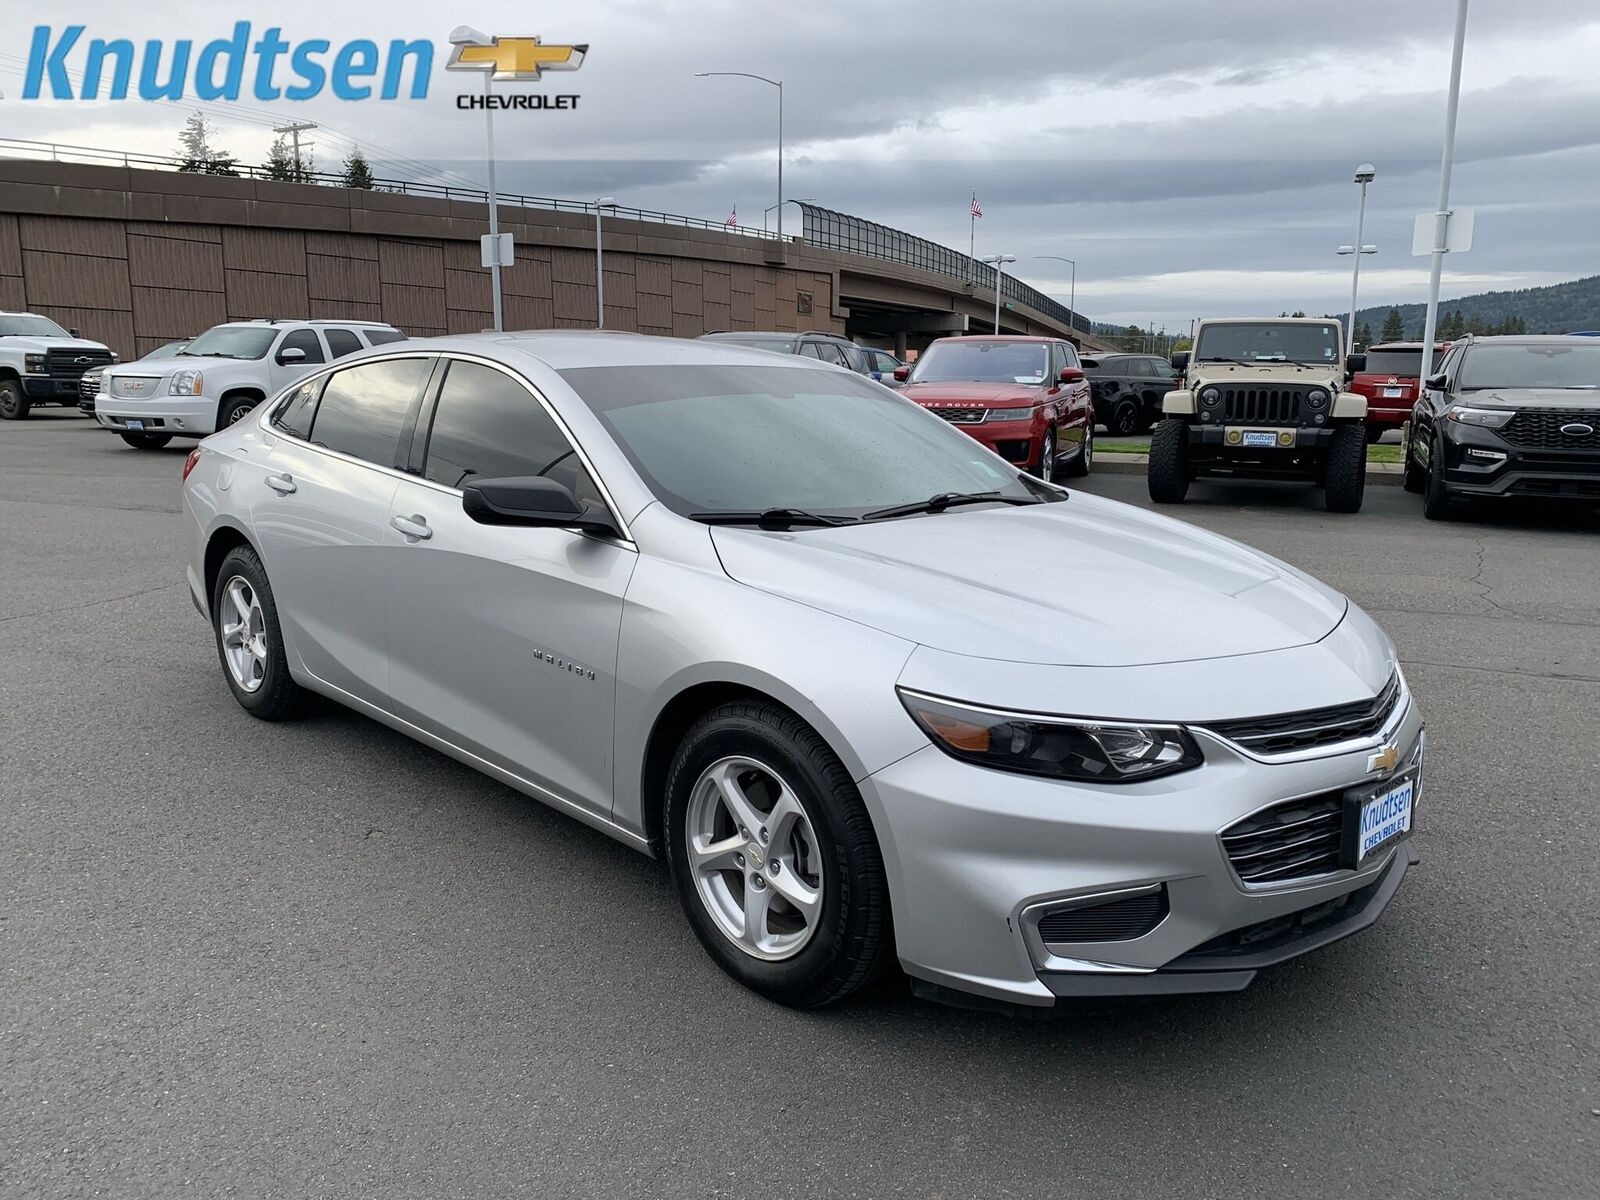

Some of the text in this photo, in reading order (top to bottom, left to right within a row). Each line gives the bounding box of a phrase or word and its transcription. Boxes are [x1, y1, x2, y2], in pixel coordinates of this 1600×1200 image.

[533, 648, 595, 681] MALIBU
[1361, 788, 1411, 835] Knudtsen
[1364, 816, 1406, 850] CHEVROLET
